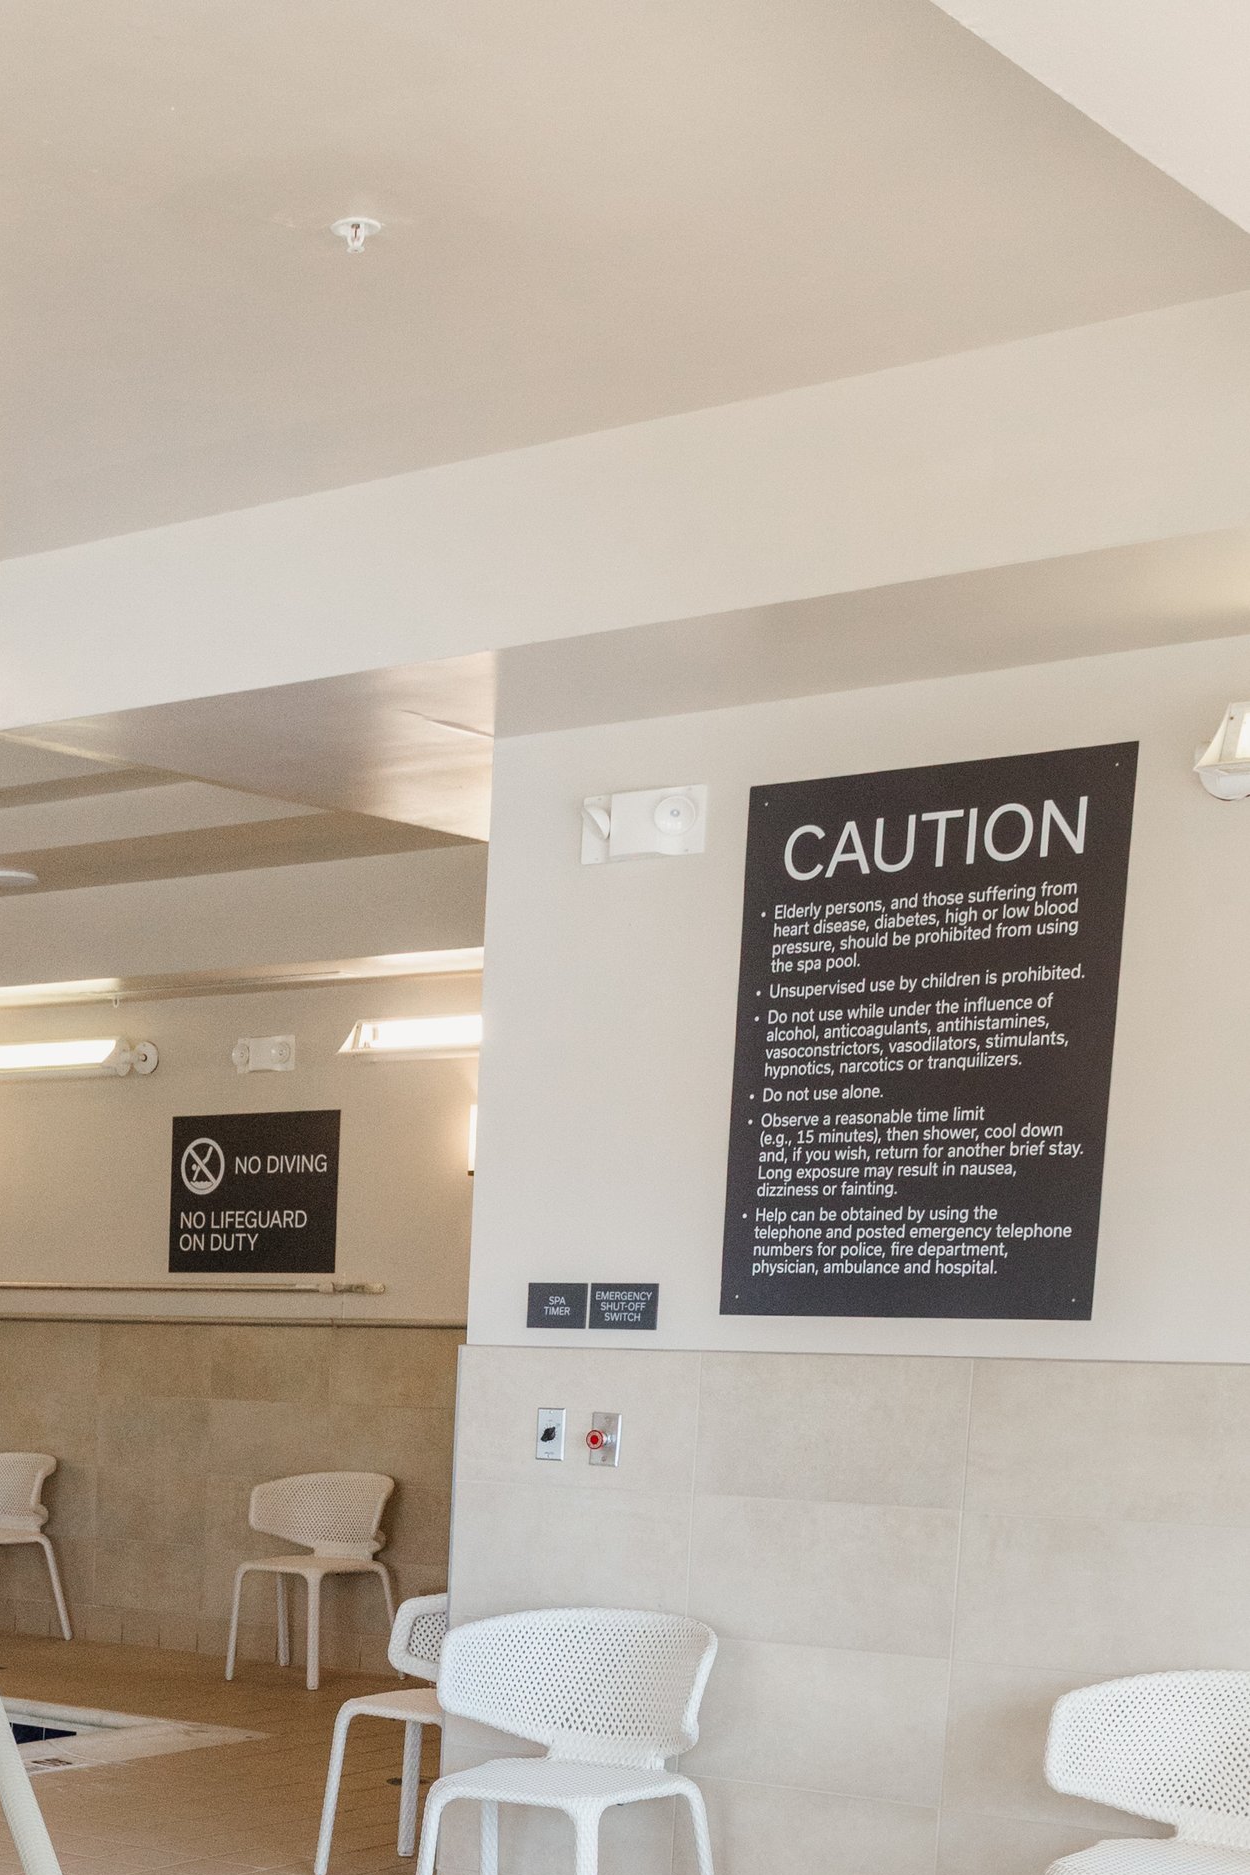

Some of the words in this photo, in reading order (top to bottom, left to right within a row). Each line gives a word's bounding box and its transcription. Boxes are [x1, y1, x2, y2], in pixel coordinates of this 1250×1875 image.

[783, 795, 1088, 880] CAUTION
[774, 901, 822, 920] Elderly
[825, 899, 886, 919] persons,
[890, 892, 919, 910] and
[922, 891, 964, 908] those
[967, 883, 1037, 904] suffering
[1040, 880, 1078, 897] from
[773, 921, 810, 938] heart
[813, 917, 870, 935] disease,
[874, 911, 940, 930] diabetes,
[944, 906, 978, 927] high
[982, 908, 999, 921] or
[1002, 903, 1030, 920] low
[1033, 897, 1079, 917] blood
[771, 939, 836, 959] pressure,
[839, 931, 889, 950] should
[892, 931, 911, 946] be
[914, 923, 992, 948] prohibited
[995, 922, 1032, 939] from
[1036, 917, 1079, 937] using
[770, 958, 794, 973] the
[796, 958, 822, 974] spa
[825, 952, 861, 973] pool.
[769, 977, 866, 1000] Unsupervised
[869, 979, 896, 992] use
[899, 975, 918, 993] by
[921, 971, 981, 989] children
[985, 969, 998, 985] is
[1001, 962, 1085, 987] prohibited.
[767, 1009, 788, 1025] Do
[791, 1008, 815, 1023] not
[818, 1008, 844, 1022] use
[846, 1003, 885, 1020] while
[888, 1000, 932, 1018] under
[935, 998, 960, 1015] the
[963, 996, 1033, 1013] influence
[1036, 991, 1054, 1009] of
[766, 1024, 820, 1043] alcohol,
[823, 1019, 932, 1040] anticoagulants,
[936, 1012, 1050, 1033] antihistamines,
[765, 1040, 884, 1060] vasoconstrictors,
[888, 1035, 981, 1054] vasodilators,
[985, 1030, 1069, 1049] stimulants,
[764, 1060, 835, 1080] hypnotics,
[839, 1056, 904, 1074] narcotics
[907, 1058, 924, 1071] or
[927, 1051, 1022, 1072] tranquilizers.
[762, 1087, 783, 1103] Do
[786, 1086, 810, 1102] not
[813, 1088, 838, 1101] use
[841, 1084, 884, 1100] alone.
[760, 1112, 820, 1128] Observe
[822, 1114, 831, 1126] a
[834, 1108, 913, 1126] reasonable
[916, 1107, 949, 1123] time
[952, 1105, 986, 1122] limit
[759, 1130, 792, 1148] (e.g.,
[796, 1129, 815, 1145] 15
[818, 1126, 882, 1145] minutes),
[885, 1126, 919, 1142] then
[922, 1125, 980, 1142] shower,
[984, 1122, 1017, 1139] cool
[1020, 1122, 1064, 1138] down
[758, 1147, 788, 1164] and,
[792, 1146, 803, 1162] if
[805, 1149, 831, 1165] you
[834, 1145, 871, 1162] wish,
[875, 1145, 919, 1160] return
[922, 1143, 944, 1159] for
[947, 1142, 1006, 1158] another
[1009, 1140, 1046, 1157] brief
[1048, 1140, 1084, 1159] stay.
[235, 1156, 261, 1175] NO
[267, 1154, 328, 1174] DIVING
[757, 1165, 793, 1183] Long
[796, 1166, 860, 1182] exposure
[863, 1165, 894, 1181] may
[897, 1161, 939, 1177] result
[942, 1160, 956, 1177] in
[959, 1163, 1017, 1177] nausea,
[756, 1181, 819, 1197] dizziness
[822, 1184, 838, 1196] or
[840, 1180, 898, 1199] fainting.
[180, 1211, 206, 1229] NO
[211, 1210, 308, 1229] LIFEGUARD
[755, 1207, 787, 1225] Help
[790, 1210, 816, 1222] can
[819, 1206, 837, 1222] be
[840, 1205, 904, 1222] obtained
[907, 1205, 926, 1224] by
[929, 1205, 970, 1224] using
[973, 1204, 998, 1221] the
[179, 1233, 205, 1251] ON
[210, 1233, 259, 1251] DUTY
[753, 1224, 823, 1242] telephone
[825, 1223, 853, 1239] and
[855, 1223, 906, 1242] posted
[909, 1226, 993, 1242] emergency
[995, 1222, 1073, 1241] telephone
[752, 1241, 814, 1257] numbers
[816, 1241, 837, 1257] for
[840, 1241, 886, 1260] police,
[890, 1241, 914, 1257] fire
[917, 1240, 1009, 1260] department,
[751, 1258, 819, 1277] physician,
[822, 1258, 901, 1275] ambulance
[903, 1259, 932, 1274] and
[934, 1258, 998, 1278] hospital.
[548, 1296, 566, 1305] SPA
[595, 1291, 653, 1301] EMERGENCY
[600, 1302, 647, 1311] SHUT-OFF
[543, 1306, 571, 1316] TIMER
[604, 1312, 641, 1322] SWITCH
